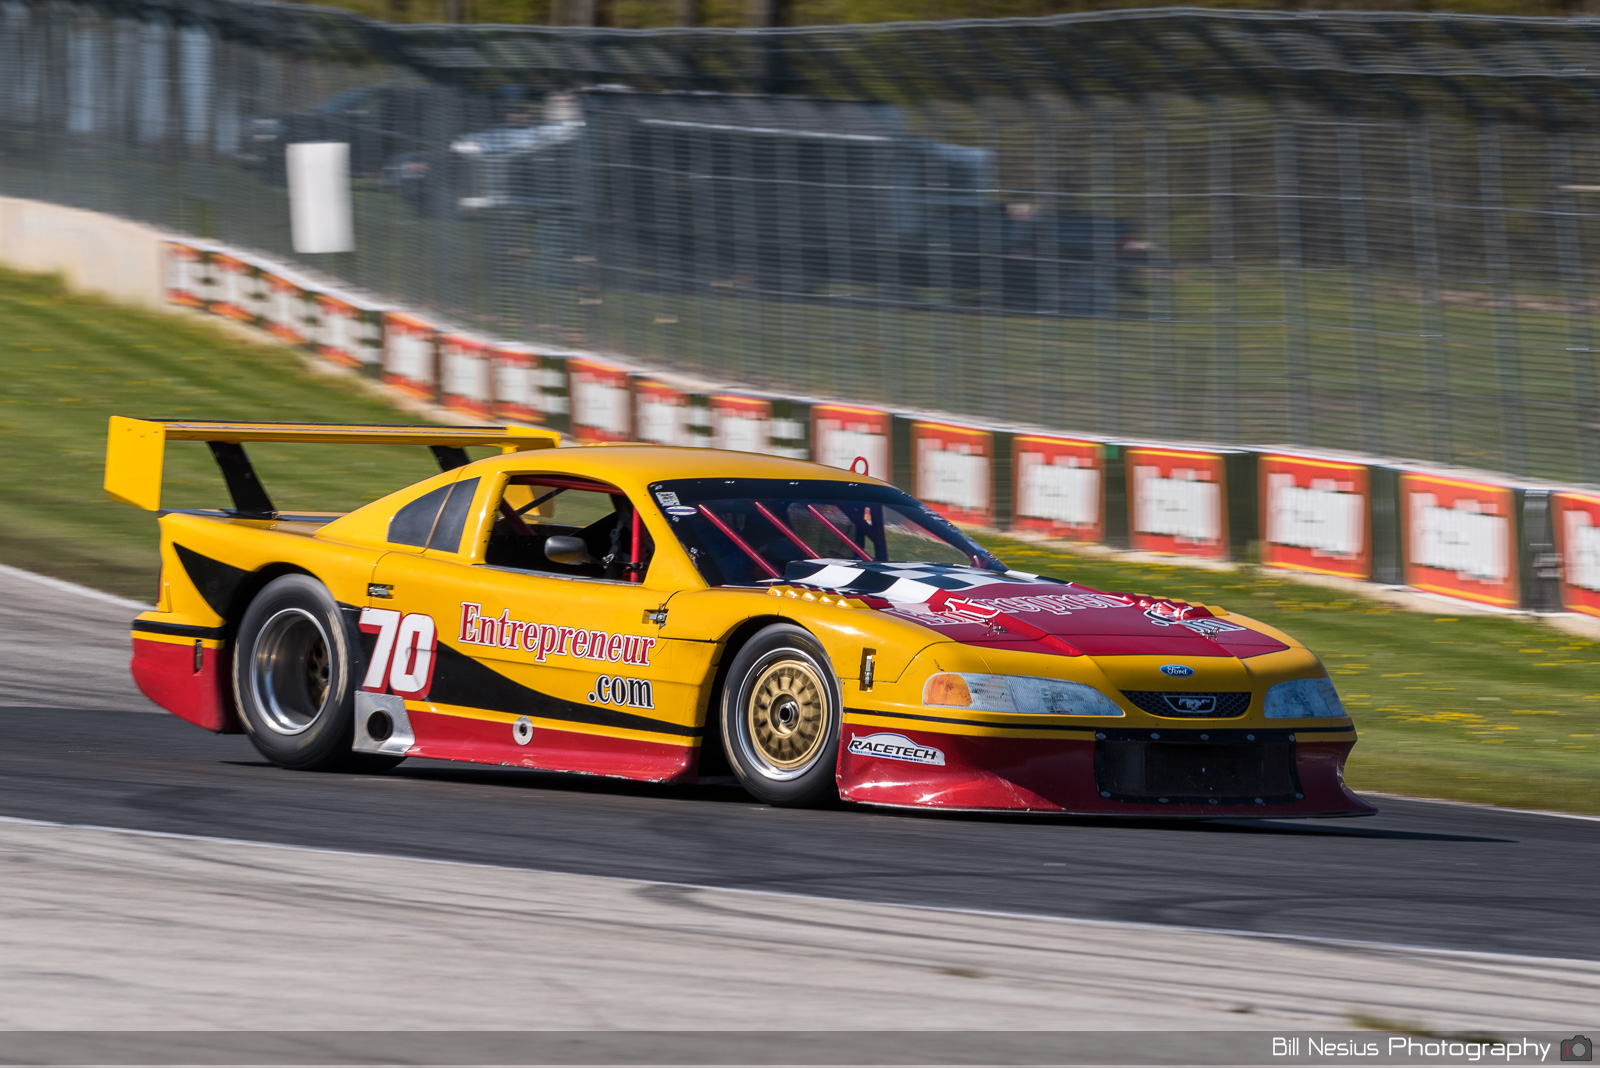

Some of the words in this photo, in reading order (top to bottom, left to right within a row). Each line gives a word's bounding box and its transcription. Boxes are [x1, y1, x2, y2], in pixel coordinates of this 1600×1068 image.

[879, 593, 1135, 625] Entrepren
[458, 601, 656, 667] Entrepreneur
[358, 606, 436, 699] 70
[1166, 665, 1188, 675] Ford
[587, 674, 655, 709] .com
[848, 739, 937, 760] RACETECH
